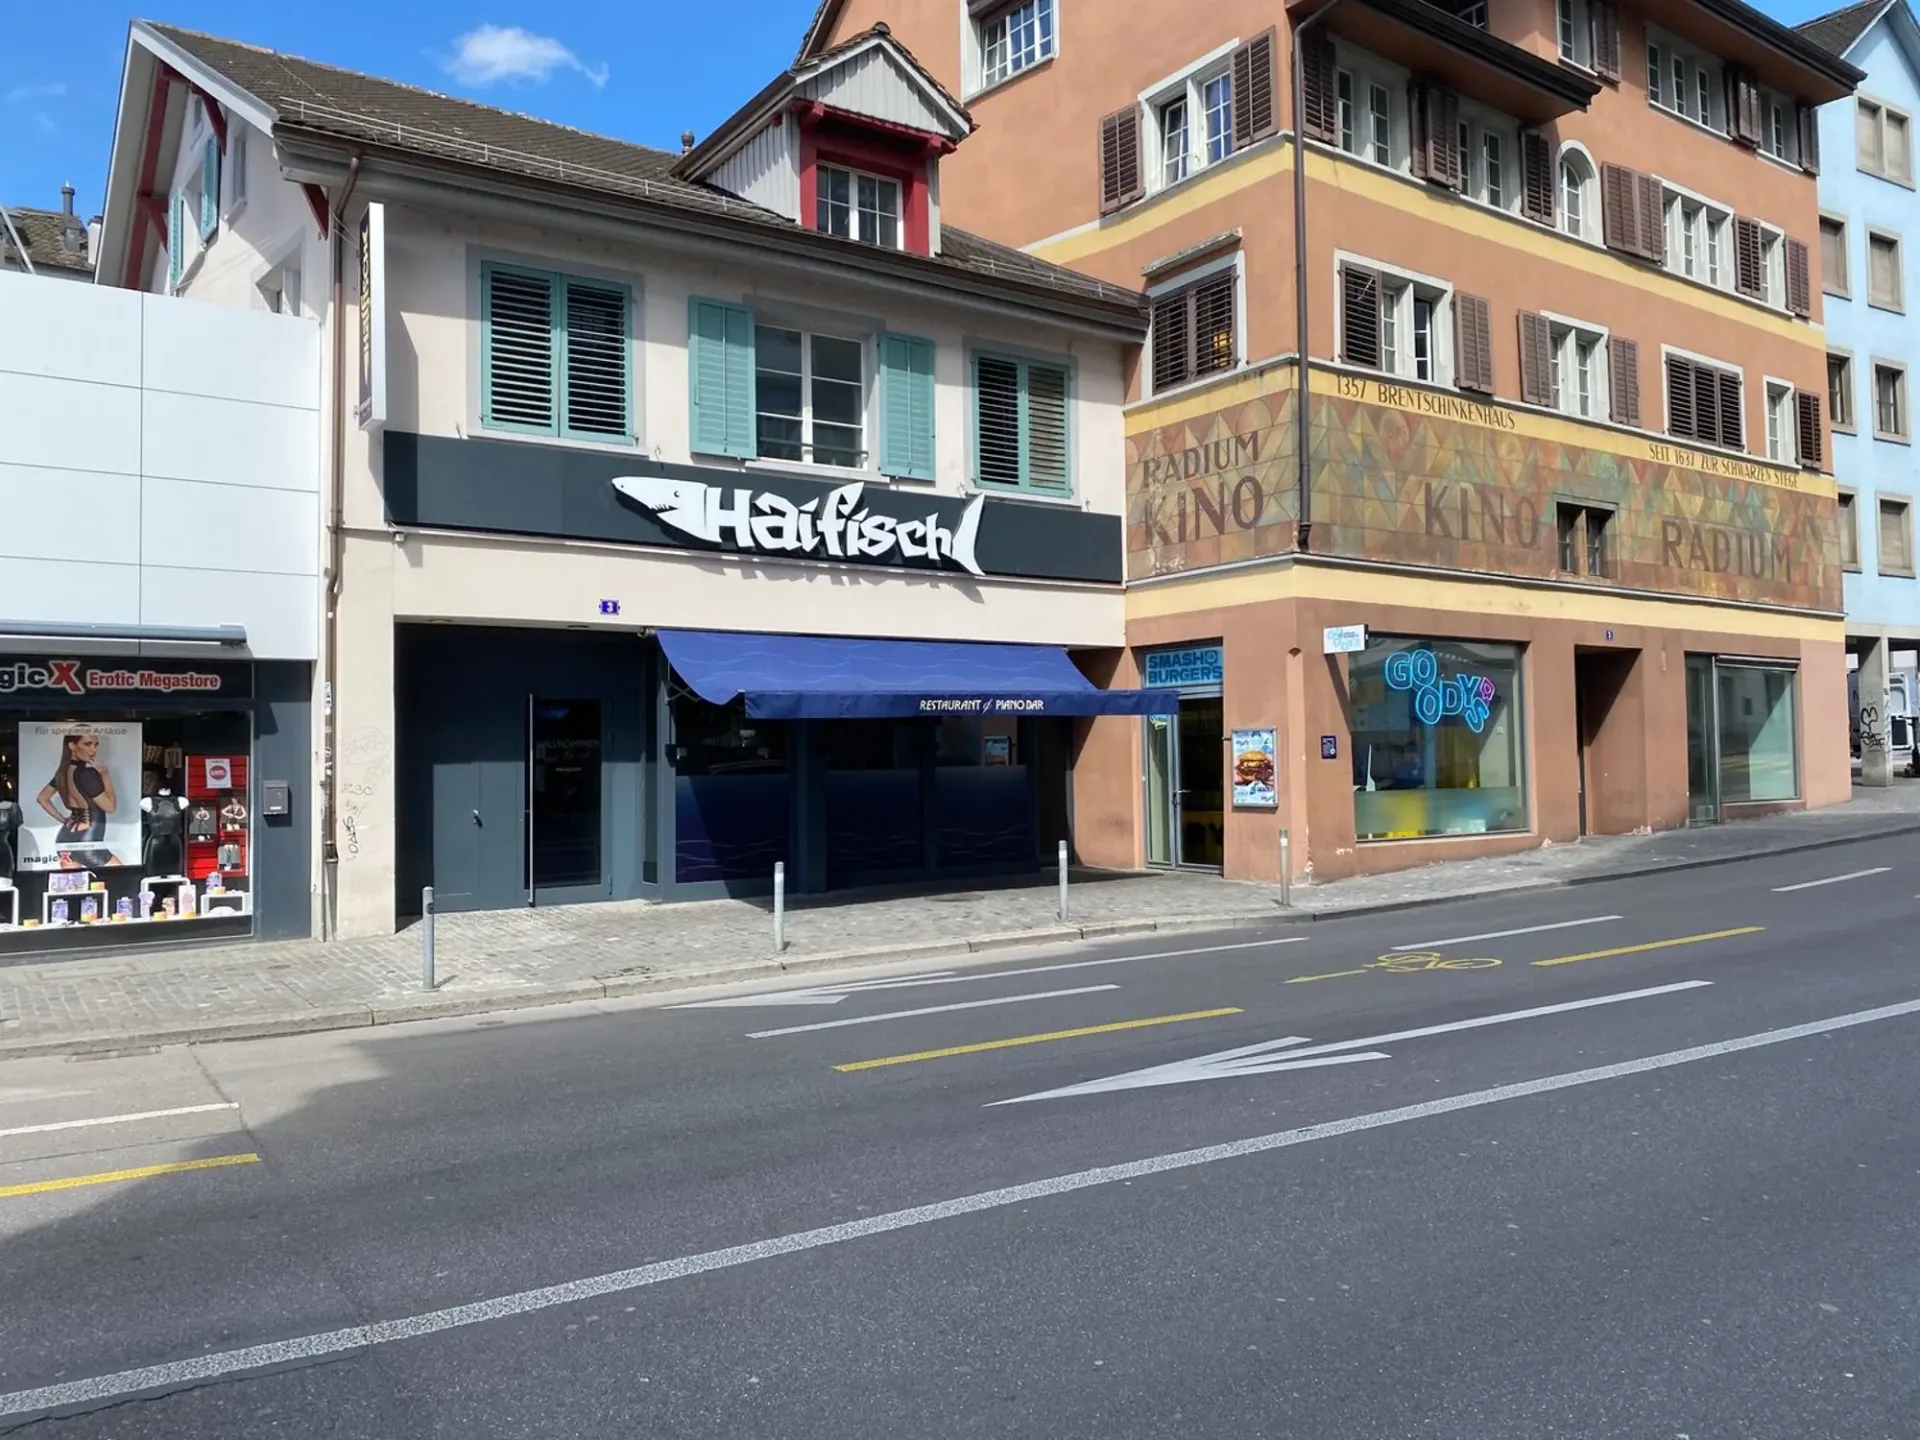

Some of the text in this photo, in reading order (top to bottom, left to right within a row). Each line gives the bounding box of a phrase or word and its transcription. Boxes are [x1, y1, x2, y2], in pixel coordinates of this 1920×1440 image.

[1336, 375, 1516, 430] 1357 BRENTSCHINKENHAUS
[1143, 430, 1259, 488] RADIUM
[1650, 444, 1670, 462] SEIT
[1674, 450, 1695, 467] 1637
[1700, 455, 1719, 472] ZUR
[1774, 471, 1799, 488] STEGE
[704, 481, 954, 560] Haifisch
[1144, 475, 1264, 546] KINO
[1424, 482, 1539, 549] KINO
[1661, 518, 1791, 583] RADIUM
[88, 670, 135, 689] Erotic
[138, 671, 221, 692] Megastore
[1148, 665, 1223, 685] BURGERS
[919, 699, 982, 711] RESTAURANT
